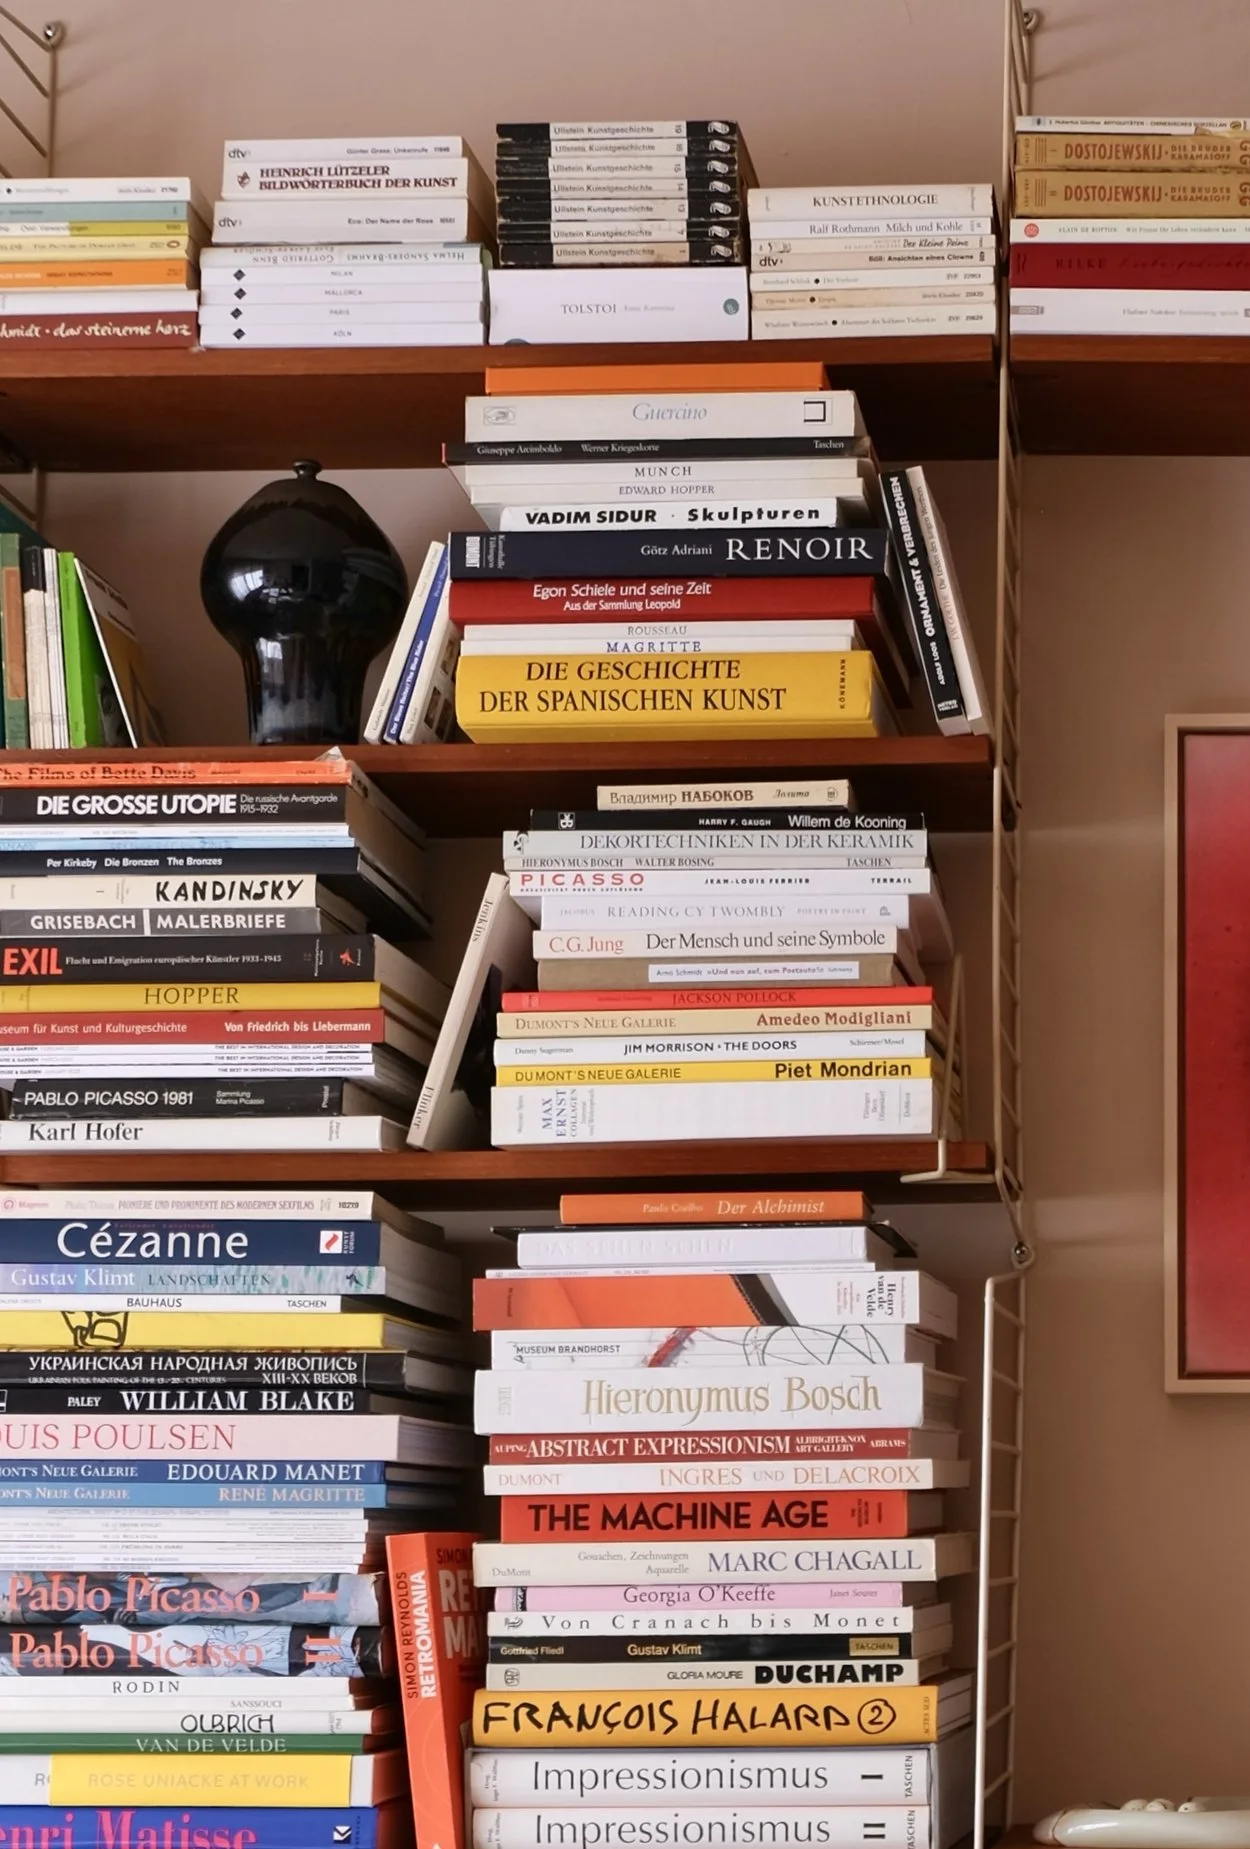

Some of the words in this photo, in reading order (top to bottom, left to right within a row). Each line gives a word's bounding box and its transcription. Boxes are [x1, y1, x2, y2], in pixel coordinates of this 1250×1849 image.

[1064, 141, 1163, 161] DOSTOJEWSKIJ
[260, 167, 323, 178] HEINRICH
[327, 164, 390, 176] LÜTZELER
[259, 177, 381, 191] BILDWÖRTERBUCH
[384, 177, 411, 189] DER
[413, 176, 458, 188] KUNST
[813, 193, 938, 207] KUNSTETHNOLOGIE
[1064, 183, 1163, 204] DOSTOJEWSKIJ
[810, 224, 829, 234] Ralf
[831, 223, 880, 234] Rothmann
[885, 222, 913, 232] Milch
[916, 222, 935, 232] und
[939, 220, 963, 232] Kohle
[634, 466, 692, 477] MUNCH
[525, 510, 591, 525] VADIM
[596, 509, 657, 524] SIDUR
[688, 505, 820, 523] Skulpturen
[641, 545, 667, 557] Götz
[672, 544, 713, 555] Adriani
[726, 537, 873, 561] RENOIR
[534, 584, 566, 599] Egon
[571, 582, 615, 597] Schiele
[620, 584, 645, 596] und
[650, 583, 683, 596] seine
[687, 582, 711, 595] Zeit
[563, 600, 581, 611] Aus
[584, 600, 597, 610] der
[600, 599, 642, 612] Sammlung
[645, 598, 681, 611] Leopold
[606, 641, 701, 653] MAGRITTE
[526, 662, 568, 680] DIE
[576, 659, 741, 680] GESCHICHTE
[479, 691, 529, 713] DER
[537, 689, 695, 712] SPANISCHEN
[703, 688, 786, 710] KUNST
[37, 796, 69, 815] DIE
[72, 795, 158, 815] GROSSE
[162, 794, 236, 814] UTOPIE
[609, 791, 677, 806] Владимир
[682, 790, 753, 802] НАБОКОВ
[580, 834, 755, 849] DEKORTECHNIKEN
[760, 835, 779, 849] IN
[785, 834, 822, 849] DER
[826, 834, 914, 849] KERAMIK
[47, 858, 61, 868] Per
[63, 857, 97, 869] Kirkeby
[105, 858, 118, 867] Die
[121, 857, 159, 867] Bronzen
[167, 857, 183, 866] The
[186, 856, 222, 866] Bronzes
[156, 879, 303, 902] KANDINSKY
[30, 915, 136, 929] GRISEBACH
[157, 914, 286, 929] MALERBRIEFE
[3, 948, 62, 975] EXIL
[57, 1222, 249, 1258] Cézanne
[127, 1298, 182, 1308] BAUHAUS
[287, 1300, 327, 1308] TASCHEN
[516, 1345, 555, 1355] MUSEUM
[558, 1344, 621, 1354] BRANDHORST
[29, 1357, 144, 1371] УКРАИНСКАЯ
[151, 1357, 248, 1373] НАРОДНАЯ
[254, 1357, 357, 1371] ЖИВОПИСЬ
[582, 1378, 771, 1426] Hieronymus
[785, 1375, 882, 1413] Bosch
[526, 1440, 629, 1458] ABSTRACT
[633, 1436, 791, 1456] EXPRESSIONISM
[528, 1503, 590, 1532] THE
[600, 1501, 752, 1531] MACHINE
[761, 1500, 829, 1528] AGE
[623, 1587, 690, 1605] Georgia
[112, 1680, 180, 1694] RODIN
[180, 1714, 274, 1734] OLBRICH
[482, 1700, 679, 1739] FRANÇOIS
[692, 1699, 850, 1735] HALARD
[533, 1761, 829, 1798] Impressionismus
